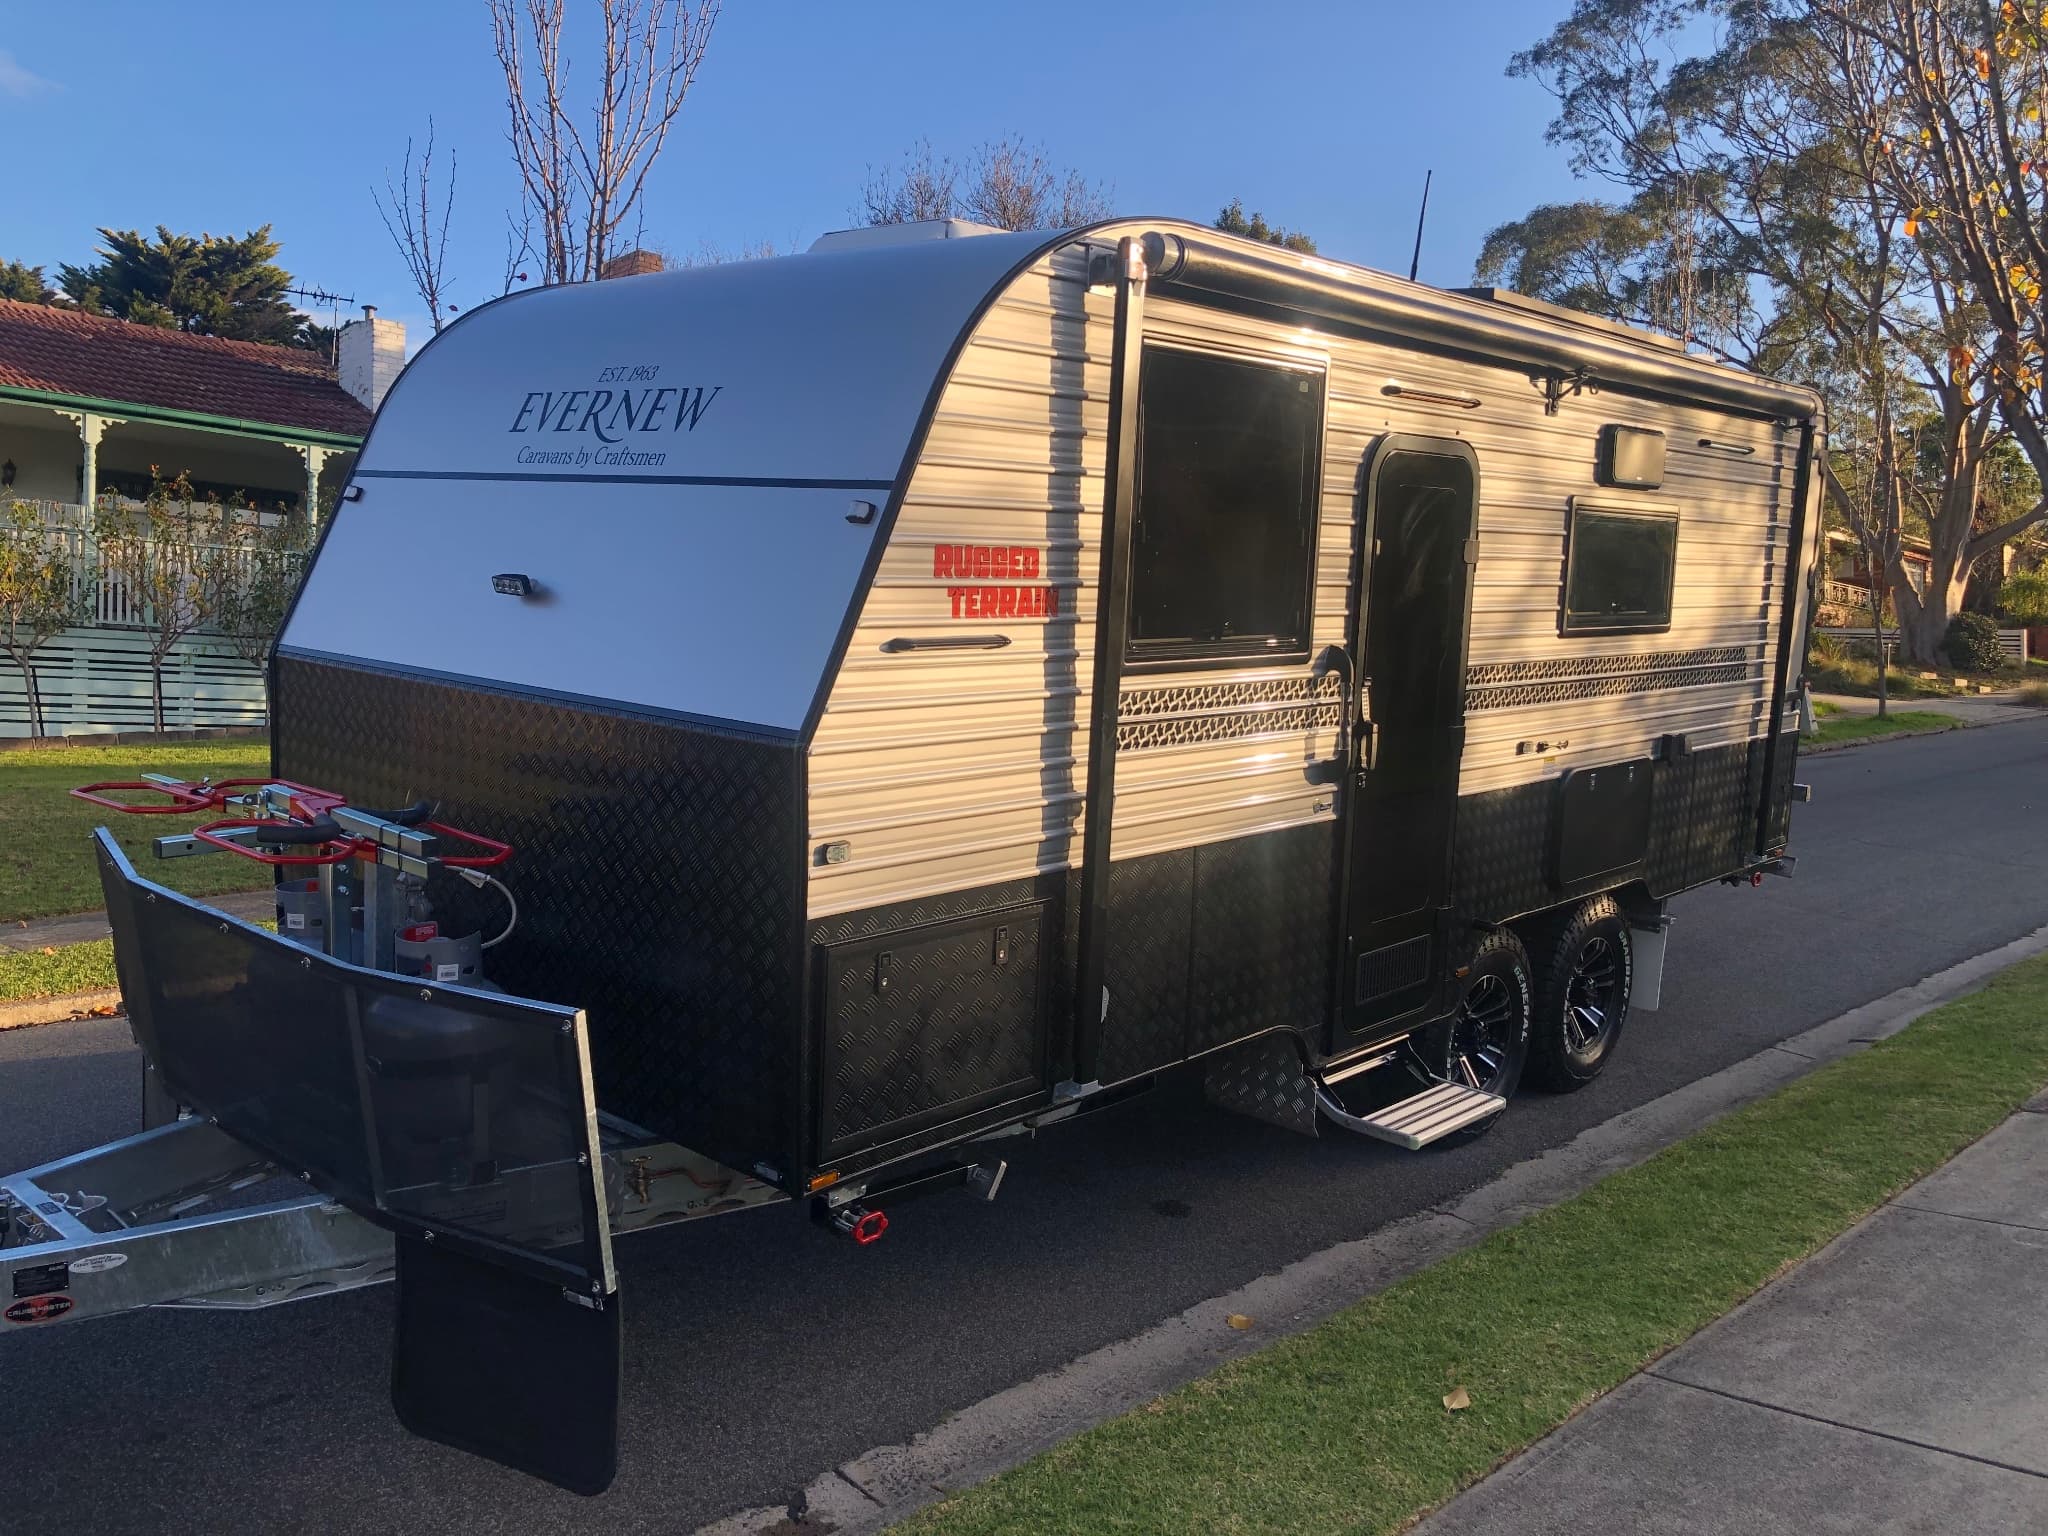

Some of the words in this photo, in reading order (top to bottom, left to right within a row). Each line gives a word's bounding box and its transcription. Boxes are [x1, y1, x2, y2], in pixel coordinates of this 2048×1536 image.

[598, 366, 628, 382] EST.
[628, 365, 660, 381] 1963
[508, 386, 724, 443] EVERNEW
[517, 446, 574, 464] Caravans
[575, 445, 593, 469] by
[594, 446, 666, 466] Craftsmen
[934, 544, 1040, 578] RUGGED
[947, 586, 1059, 618] TERRAIN
[1513, 965, 1530, 1042] GENERAL
